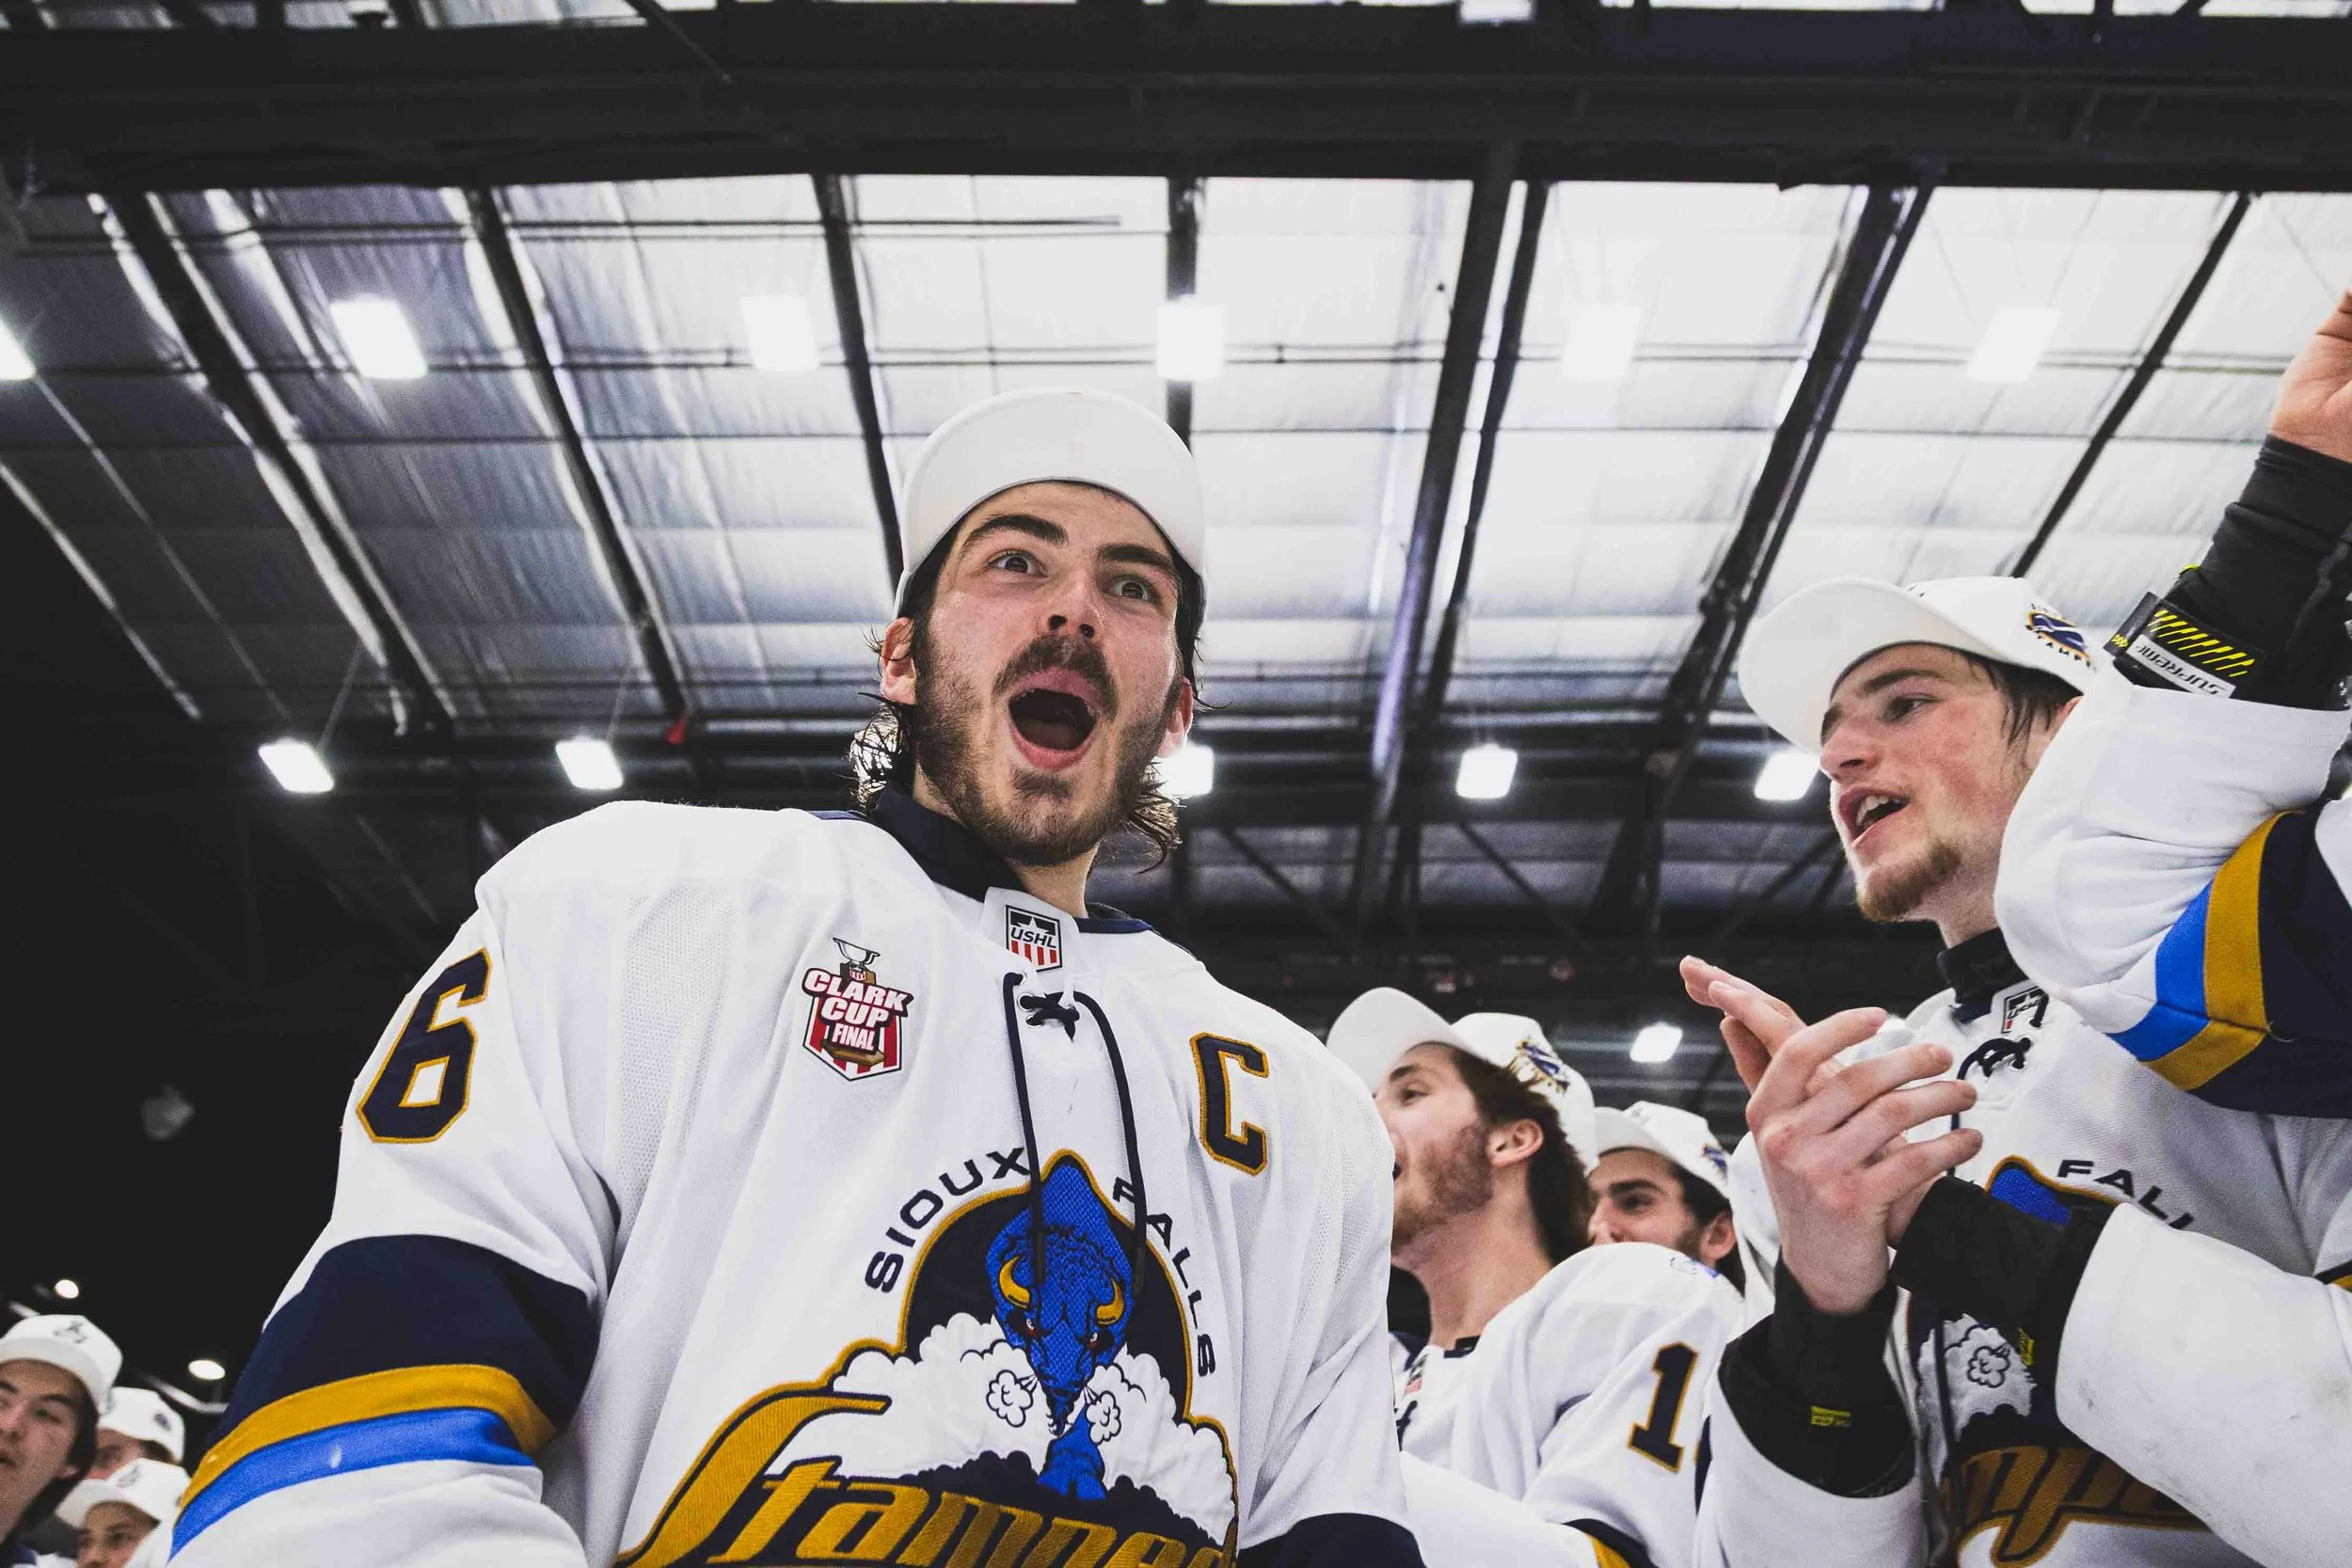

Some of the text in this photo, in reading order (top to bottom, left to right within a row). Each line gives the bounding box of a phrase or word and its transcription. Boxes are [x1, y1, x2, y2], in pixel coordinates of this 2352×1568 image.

[1010, 927, 1057, 948] USHL
[803, 968, 910, 1012] CLARK
[820, 996, 890, 1028] CUP
[832, 1022, 876, 1052] FINAL
[356, 947, 492, 1144] 6
[1189, 1032, 1269, 1177] C
[865, 1147, 1216, 1377] SIOUX FALLS
[1627, 1341, 1711, 1486] 1
